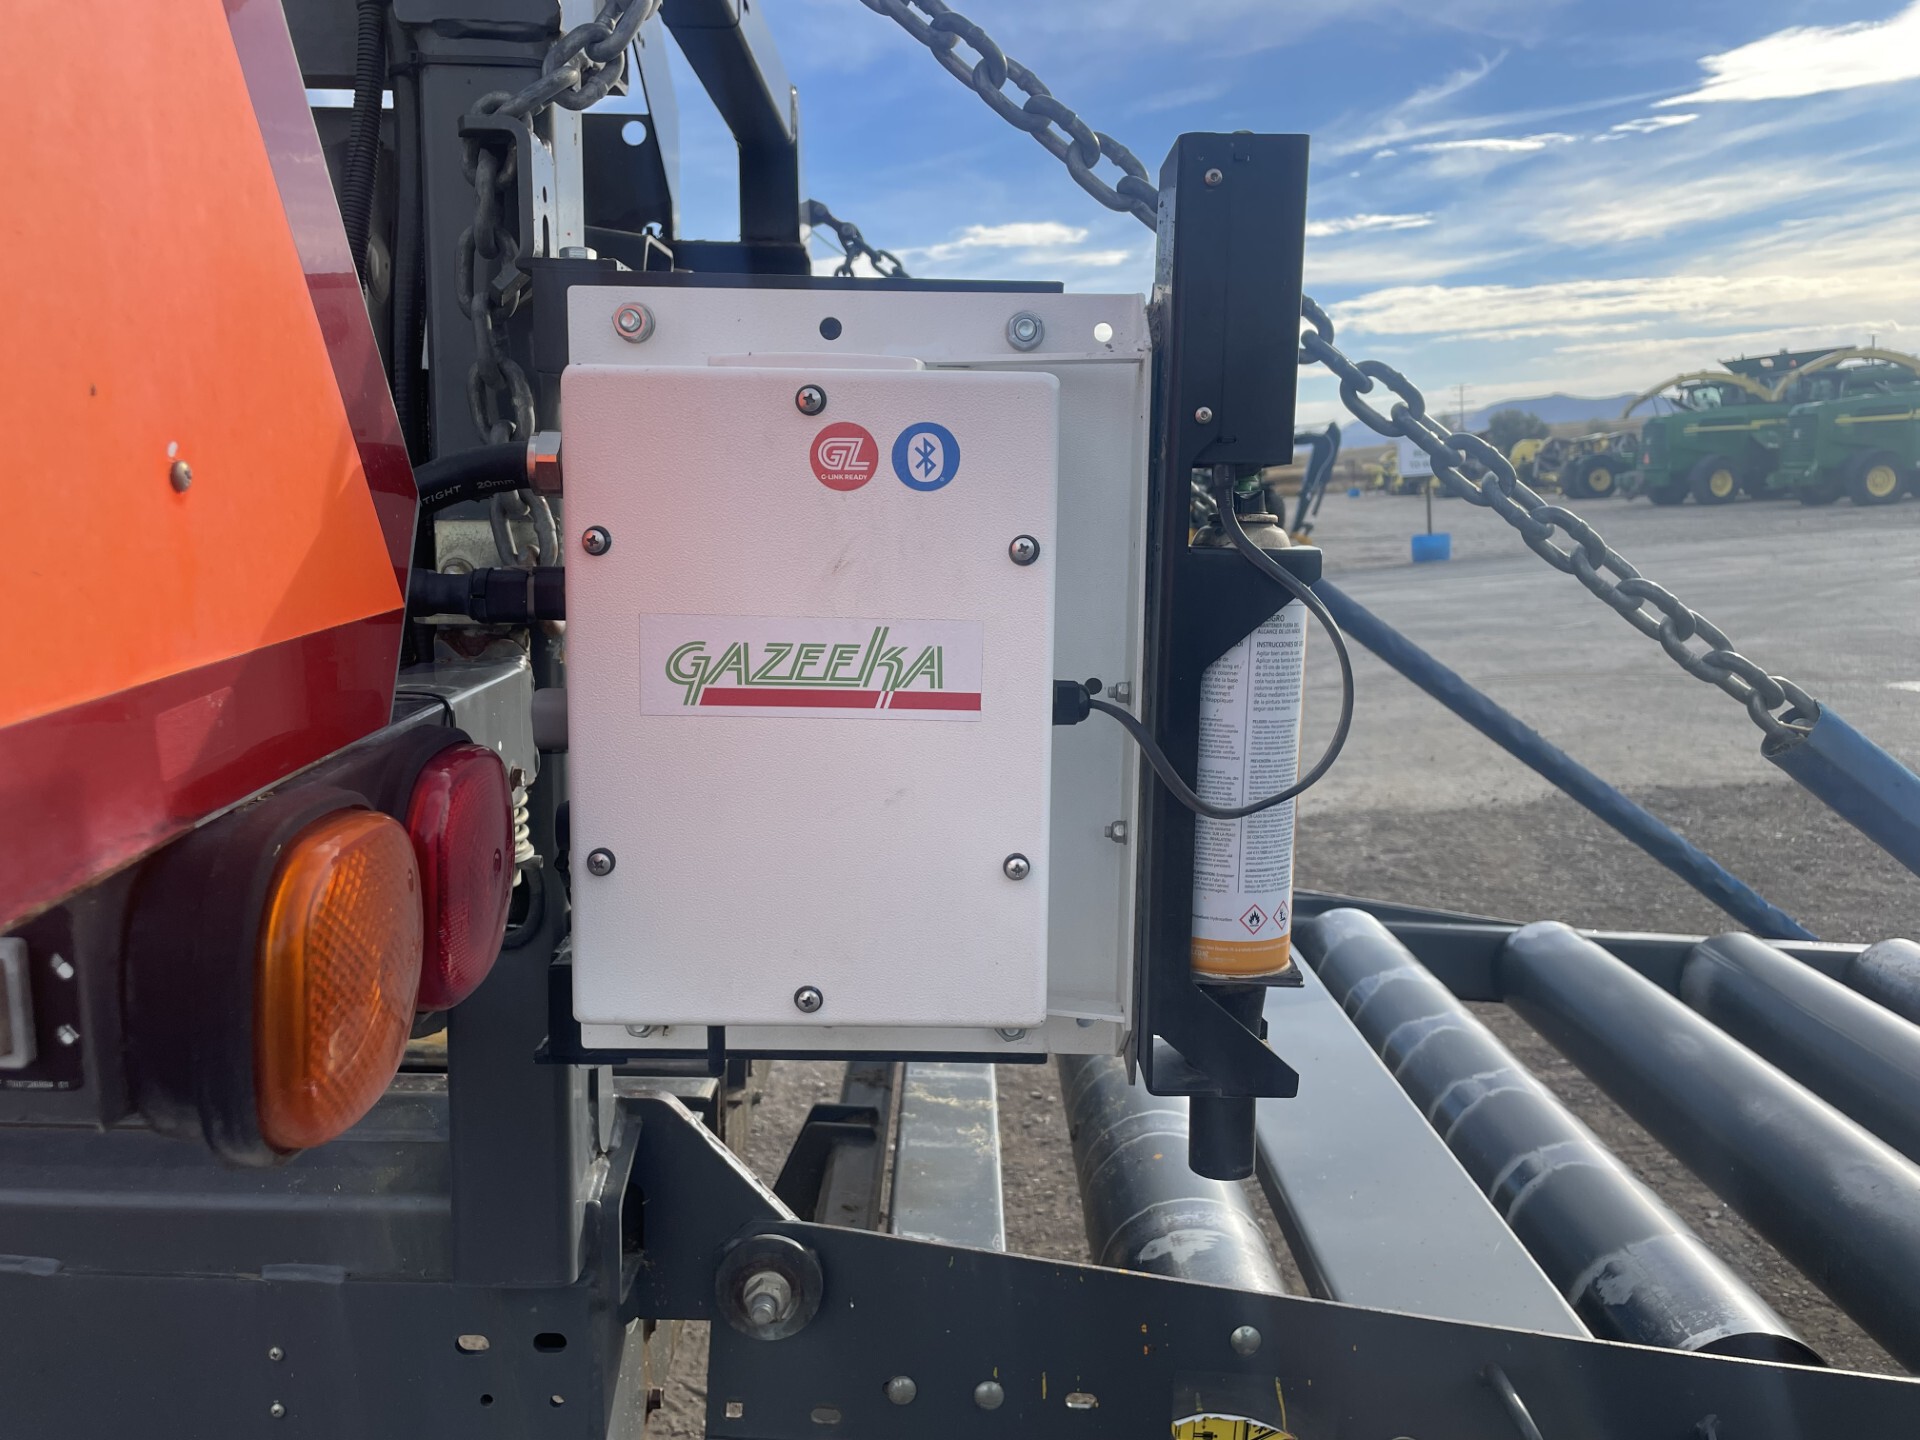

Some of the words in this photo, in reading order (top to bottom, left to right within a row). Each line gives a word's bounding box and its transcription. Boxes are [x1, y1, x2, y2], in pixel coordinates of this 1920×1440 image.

[420, 484, 461, 505] TIGHT
[476, 479, 516, 489] 20mm
[664, 626, 944, 706] GAZEEKA
